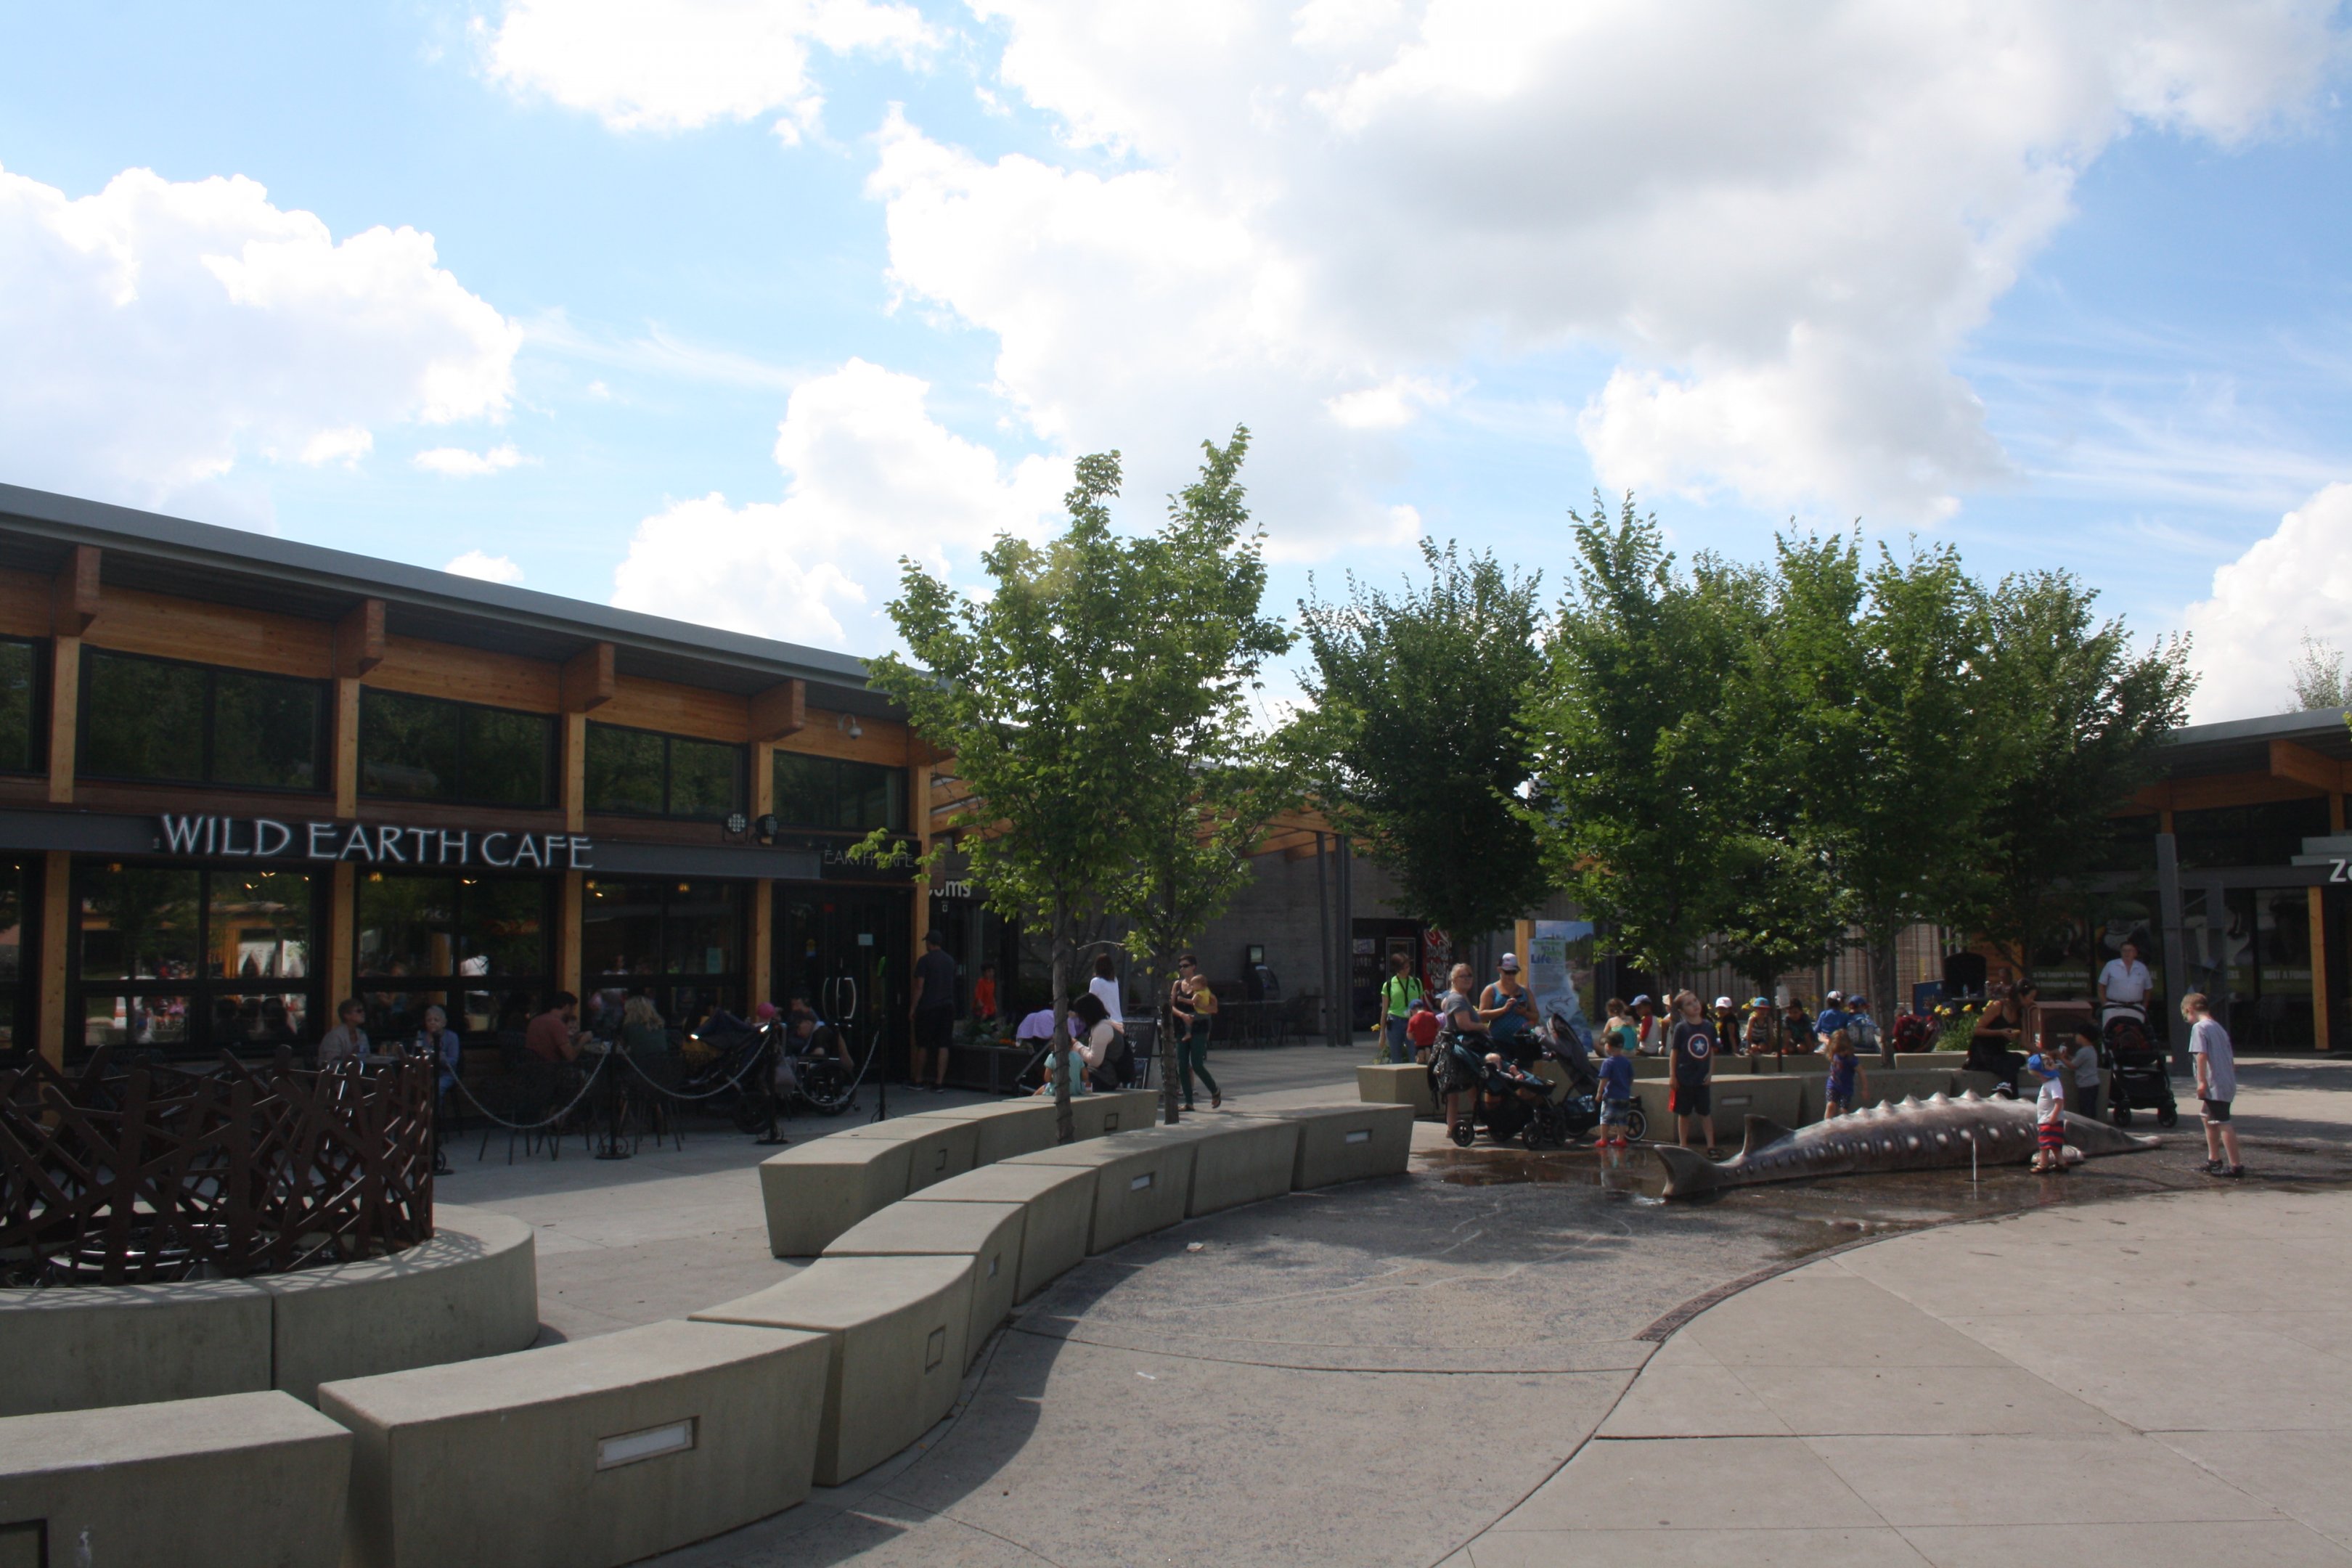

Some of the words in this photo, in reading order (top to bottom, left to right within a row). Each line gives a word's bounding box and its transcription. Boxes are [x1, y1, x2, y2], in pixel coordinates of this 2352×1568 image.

[161, 814, 291, 857] WILD
[307, 822, 468, 865] EARTH
[481, 832, 594, 869] CAFE
